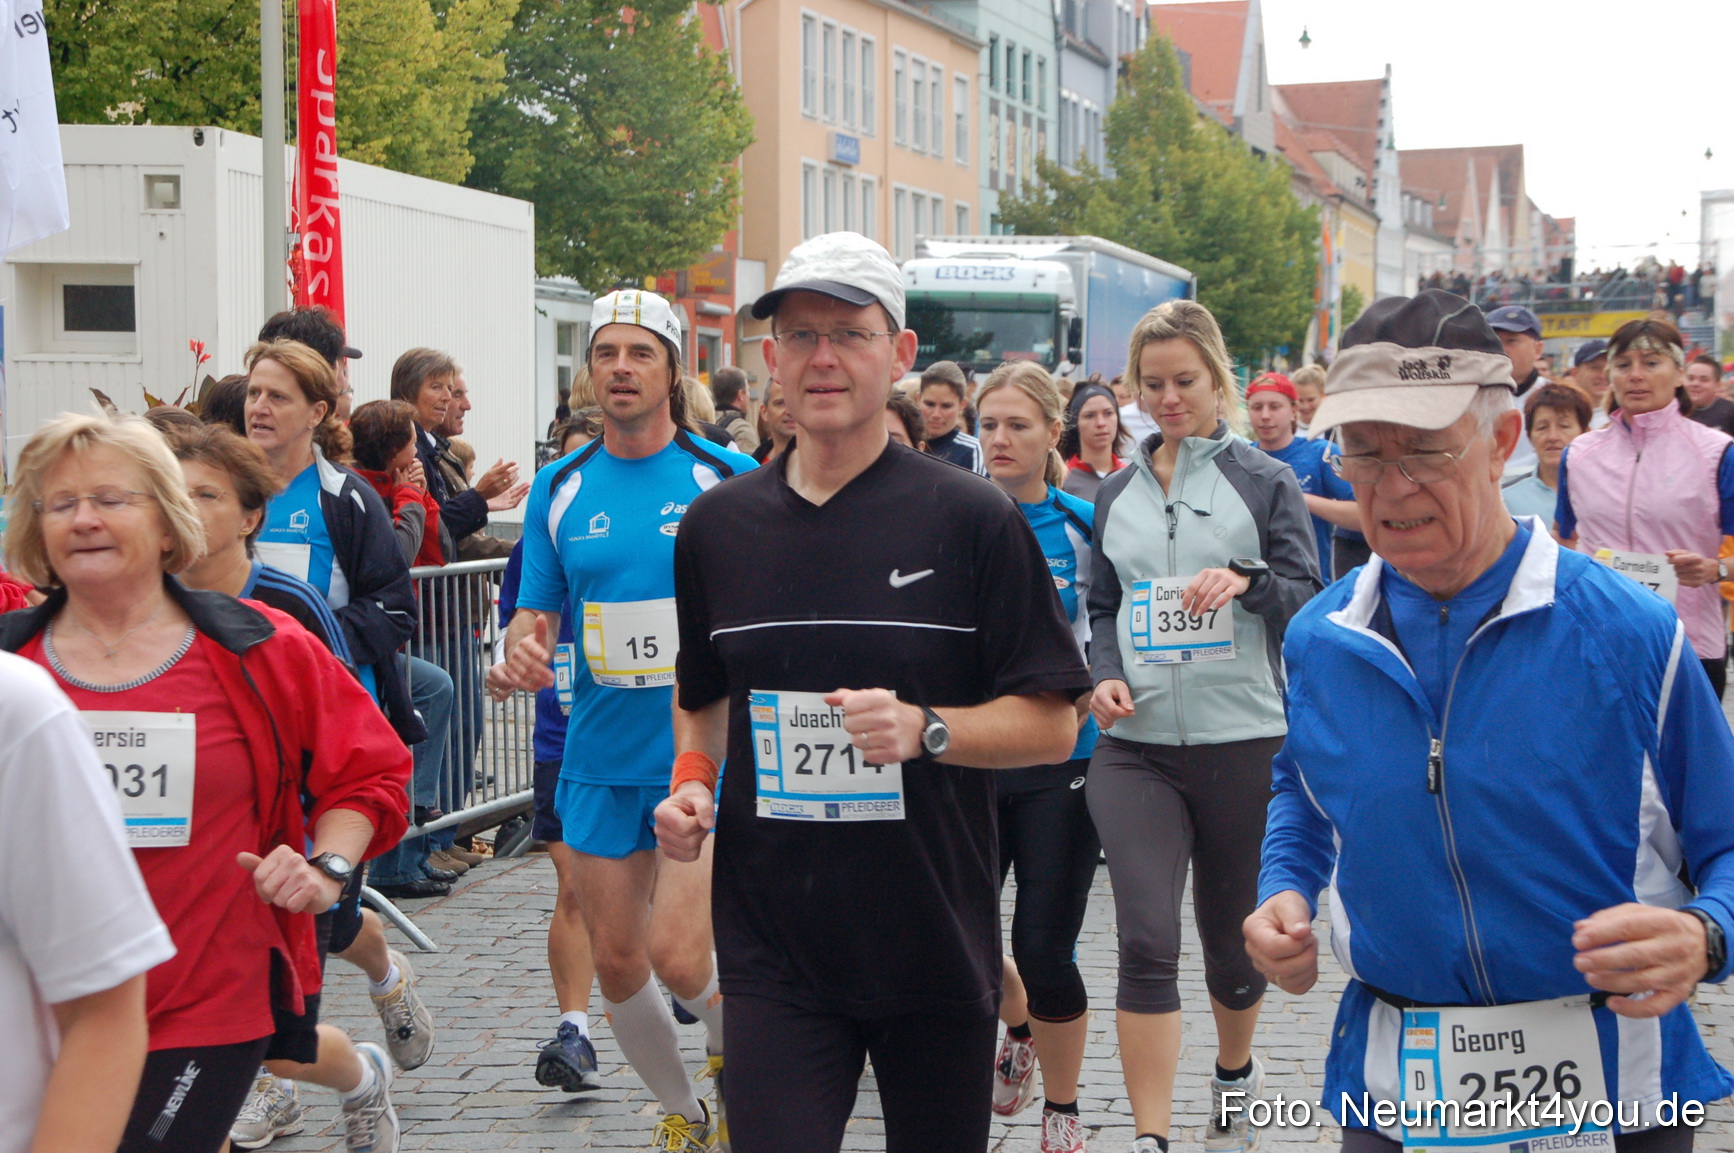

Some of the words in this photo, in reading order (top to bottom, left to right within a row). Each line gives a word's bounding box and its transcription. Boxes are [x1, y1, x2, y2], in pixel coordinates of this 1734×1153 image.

[935, 265, 1016, 281] BOCK
[1402, 359, 1427, 370] Jack
[1398, 366, 1452, 380] Wolfskin
[1135, 611, 1142, 623] D
[1158, 609, 1219, 633] 3397
[626, 635, 659, 660] 15
[1192, 647, 1233, 657] PFLEIDERER
[763, 739, 772, 755] D
[841, 801, 901, 813] PFLEIDERER
[1452, 1025, 1525, 1054] Georg
[1415, 1071, 1425, 1091] D
[1459, 1060, 1582, 1112] 2526
[1531, 1133, 1610, 1151] PFLEIDERER
